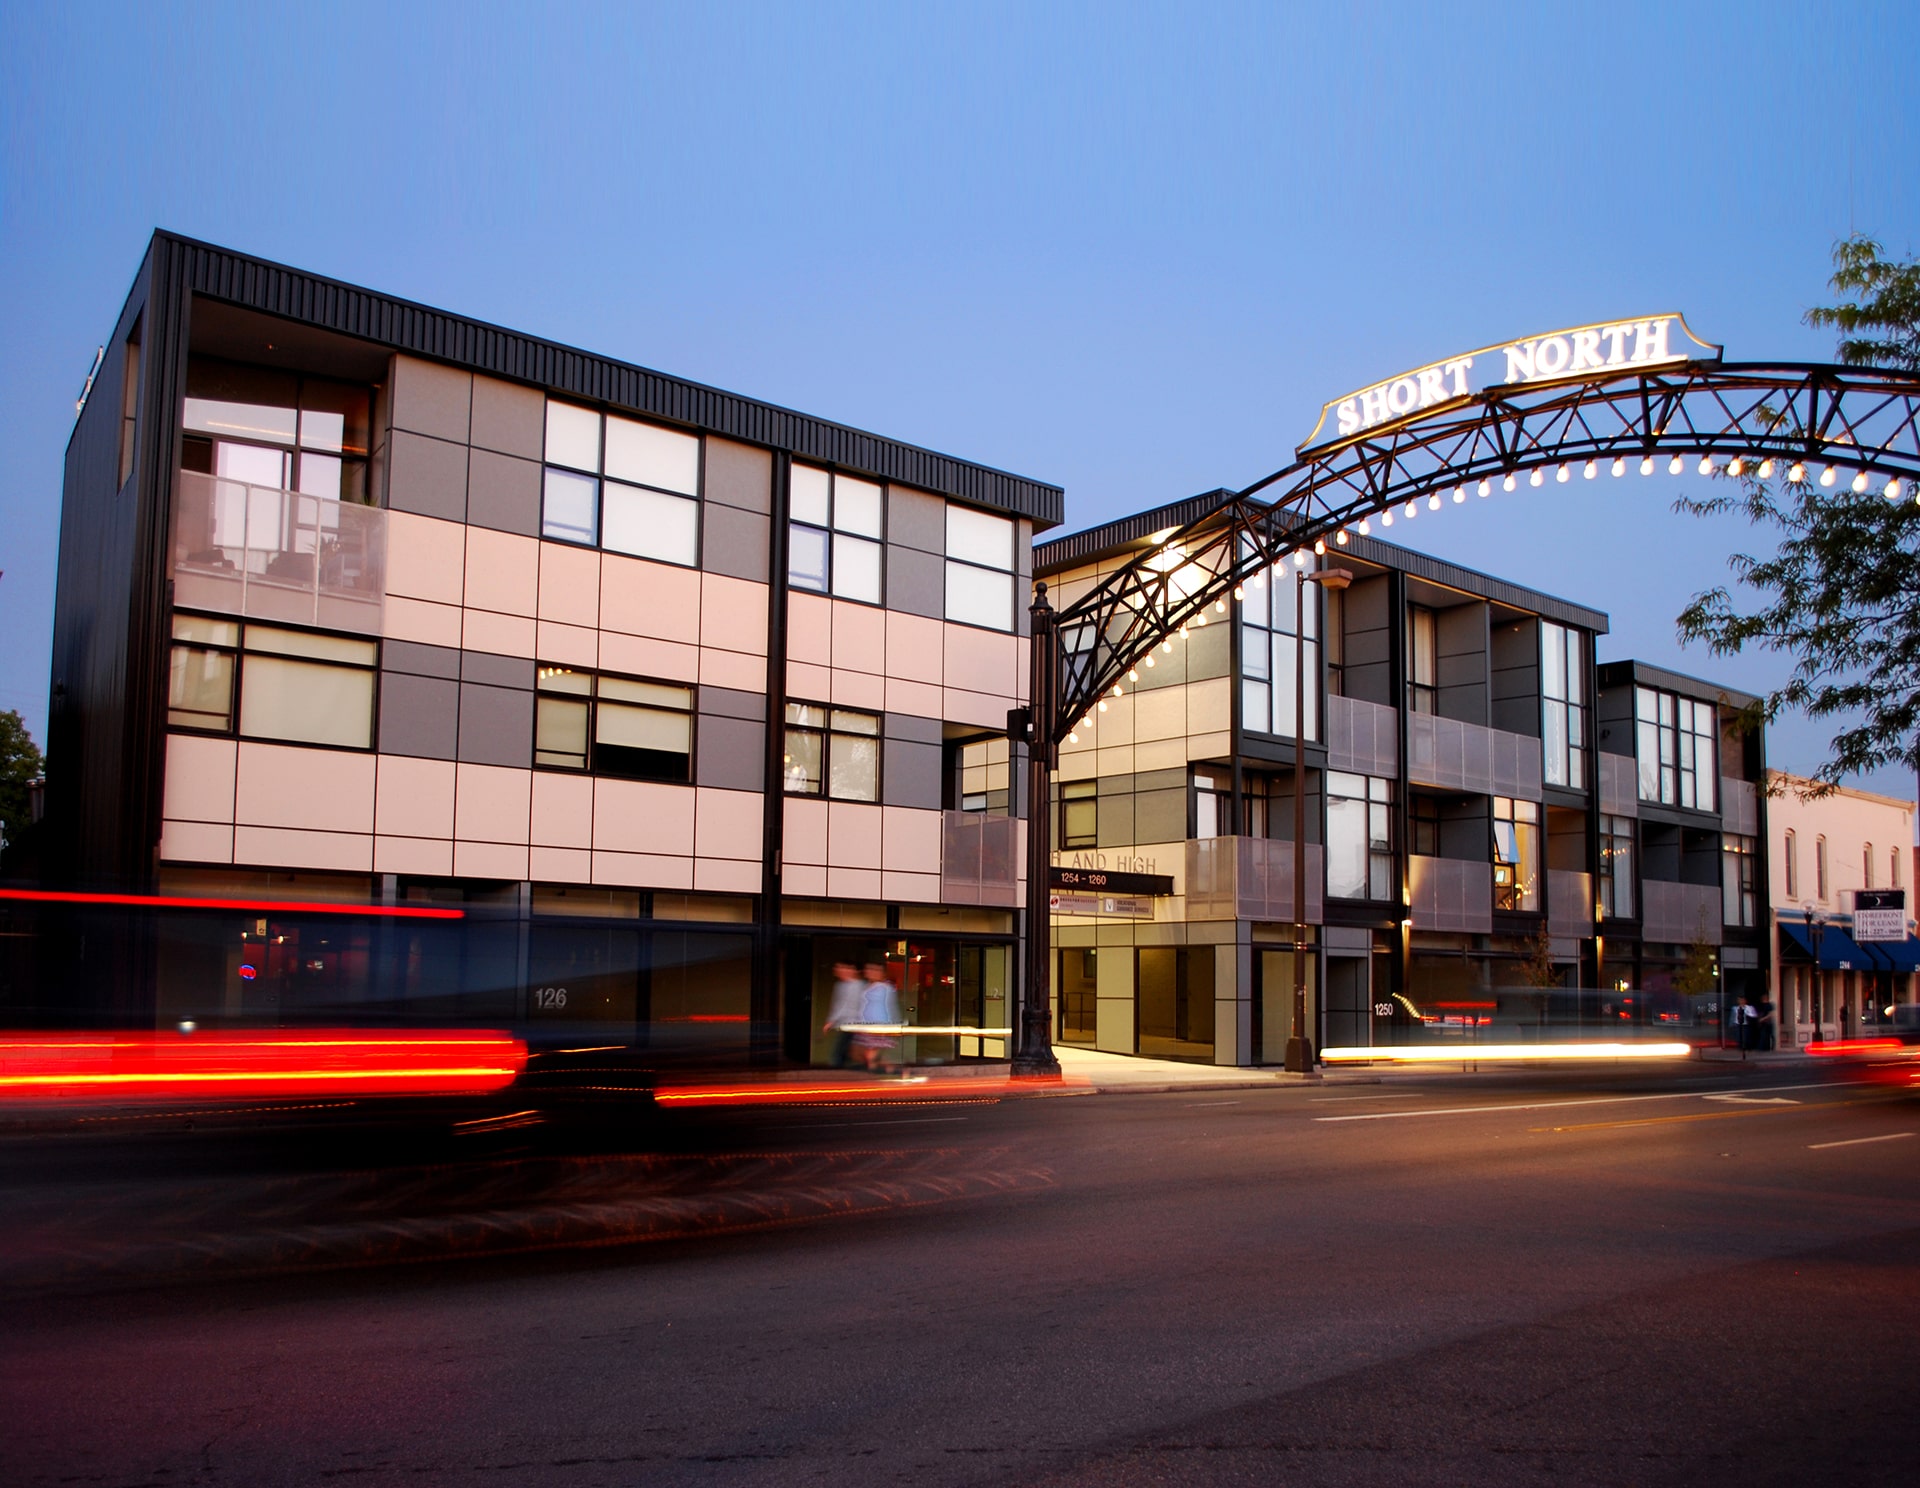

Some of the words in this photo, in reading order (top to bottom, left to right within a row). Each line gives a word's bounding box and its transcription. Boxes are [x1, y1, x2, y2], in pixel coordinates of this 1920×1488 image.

[1337, 358, 1473, 435] SHORT
[1503, 319, 1671, 383] NORTH
[1072, 851, 1107, 871] AND
[1117, 855, 1156, 875] HIGH
[1061, 872, 1079, 884] 1254
[1088, 874, 1107, 886] 1260
[1857, 911, 1903, 919] STOREFRONT
[1374, 1003, 1394, 1016] 1250
